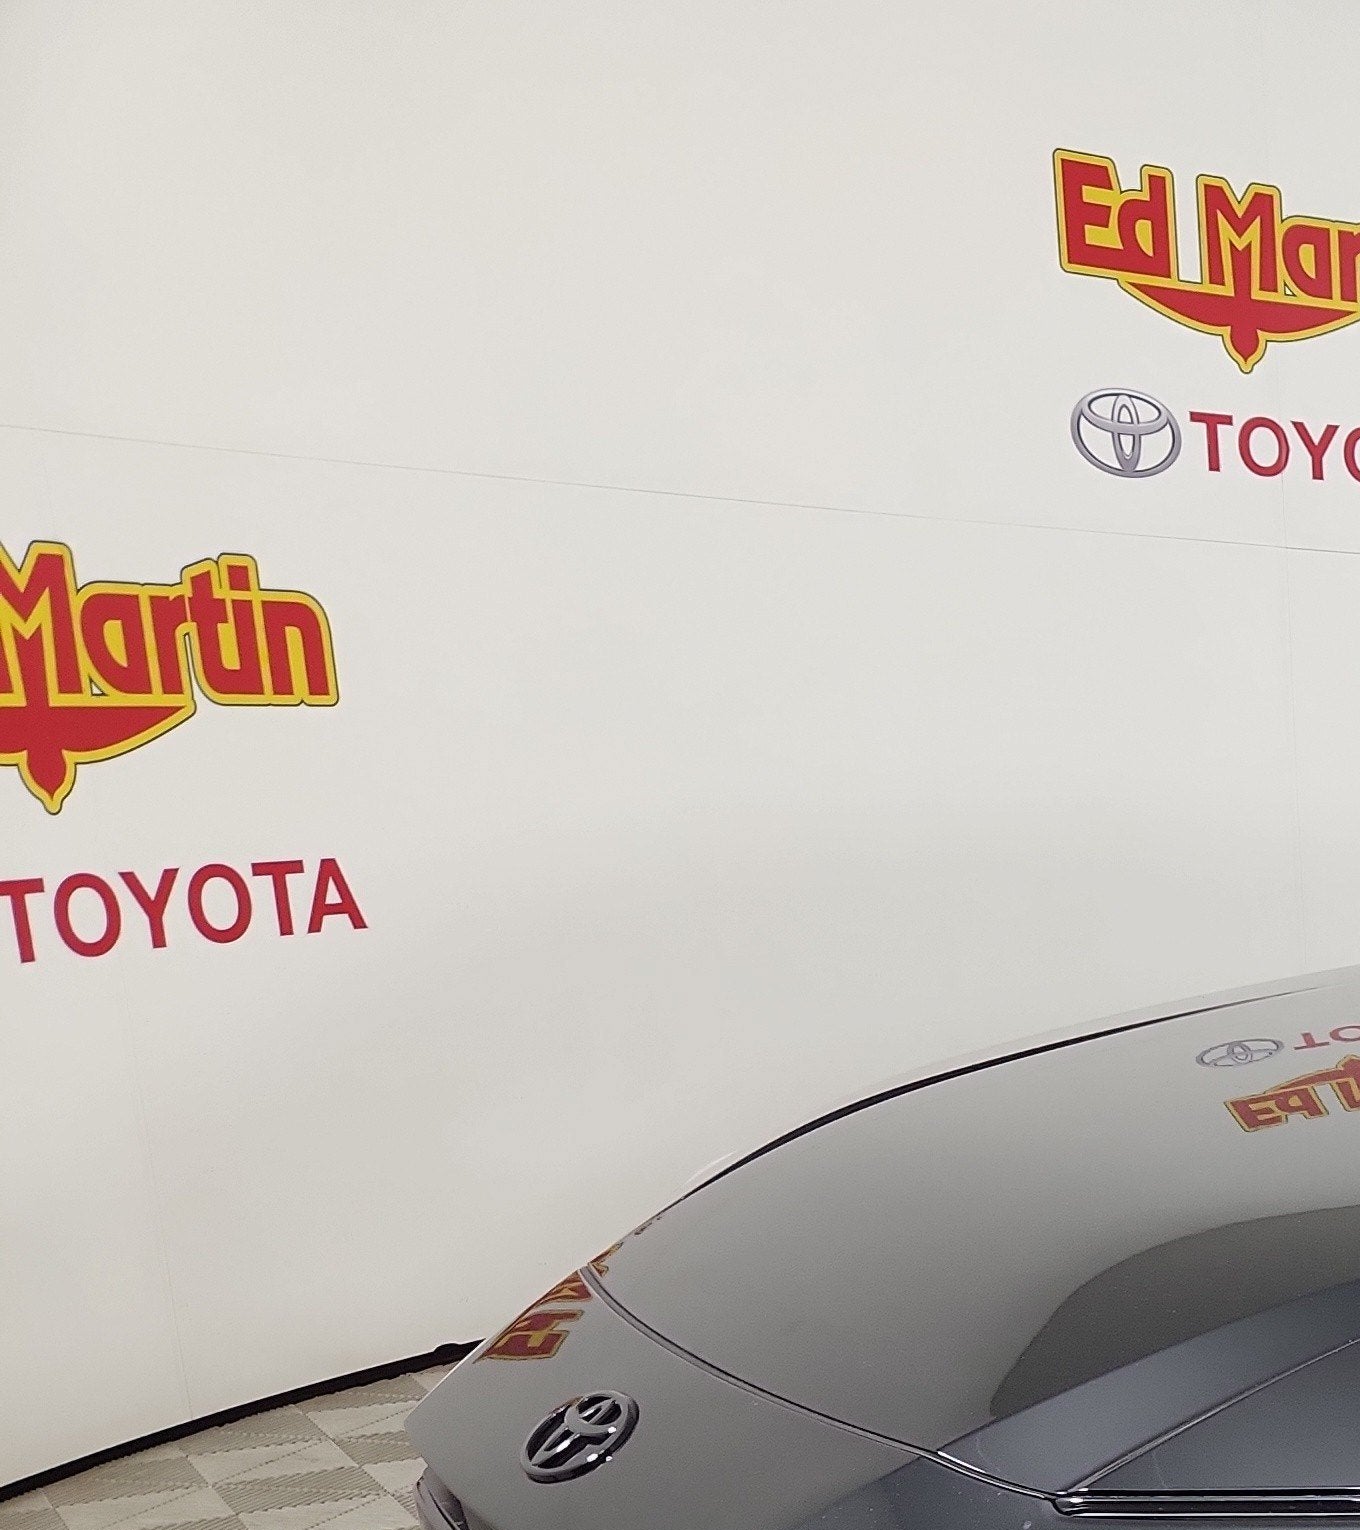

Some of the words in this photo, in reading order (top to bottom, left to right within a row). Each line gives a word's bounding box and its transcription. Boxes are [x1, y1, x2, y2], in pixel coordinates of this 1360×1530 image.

[1053, 148, 1178, 281] Ed
[0, 540, 339, 708] Martin
[0, 857, 369, 964] TOYOTA
